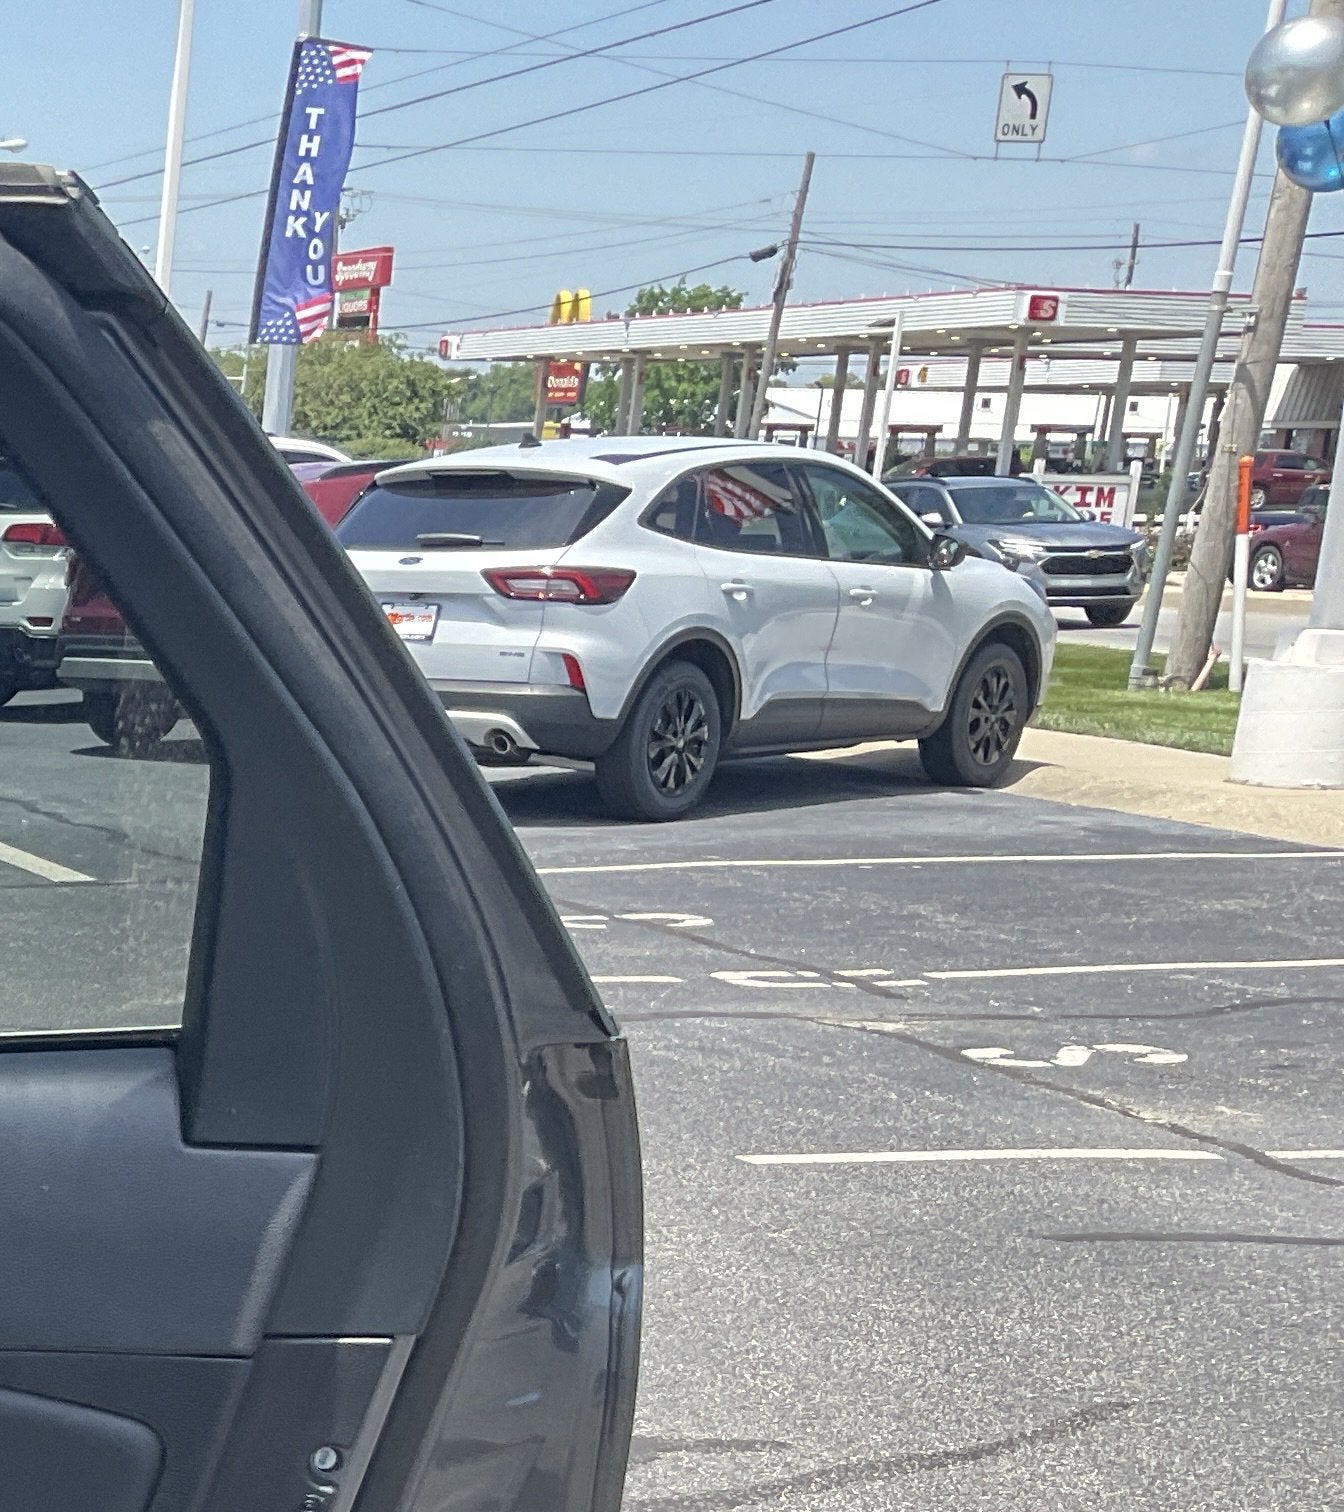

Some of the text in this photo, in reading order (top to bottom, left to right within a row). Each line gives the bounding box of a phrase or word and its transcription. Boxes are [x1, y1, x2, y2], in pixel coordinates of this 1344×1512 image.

[1001, 123, 1039, 137] ONLY
[285, 107, 330, 286] THANK YOU
